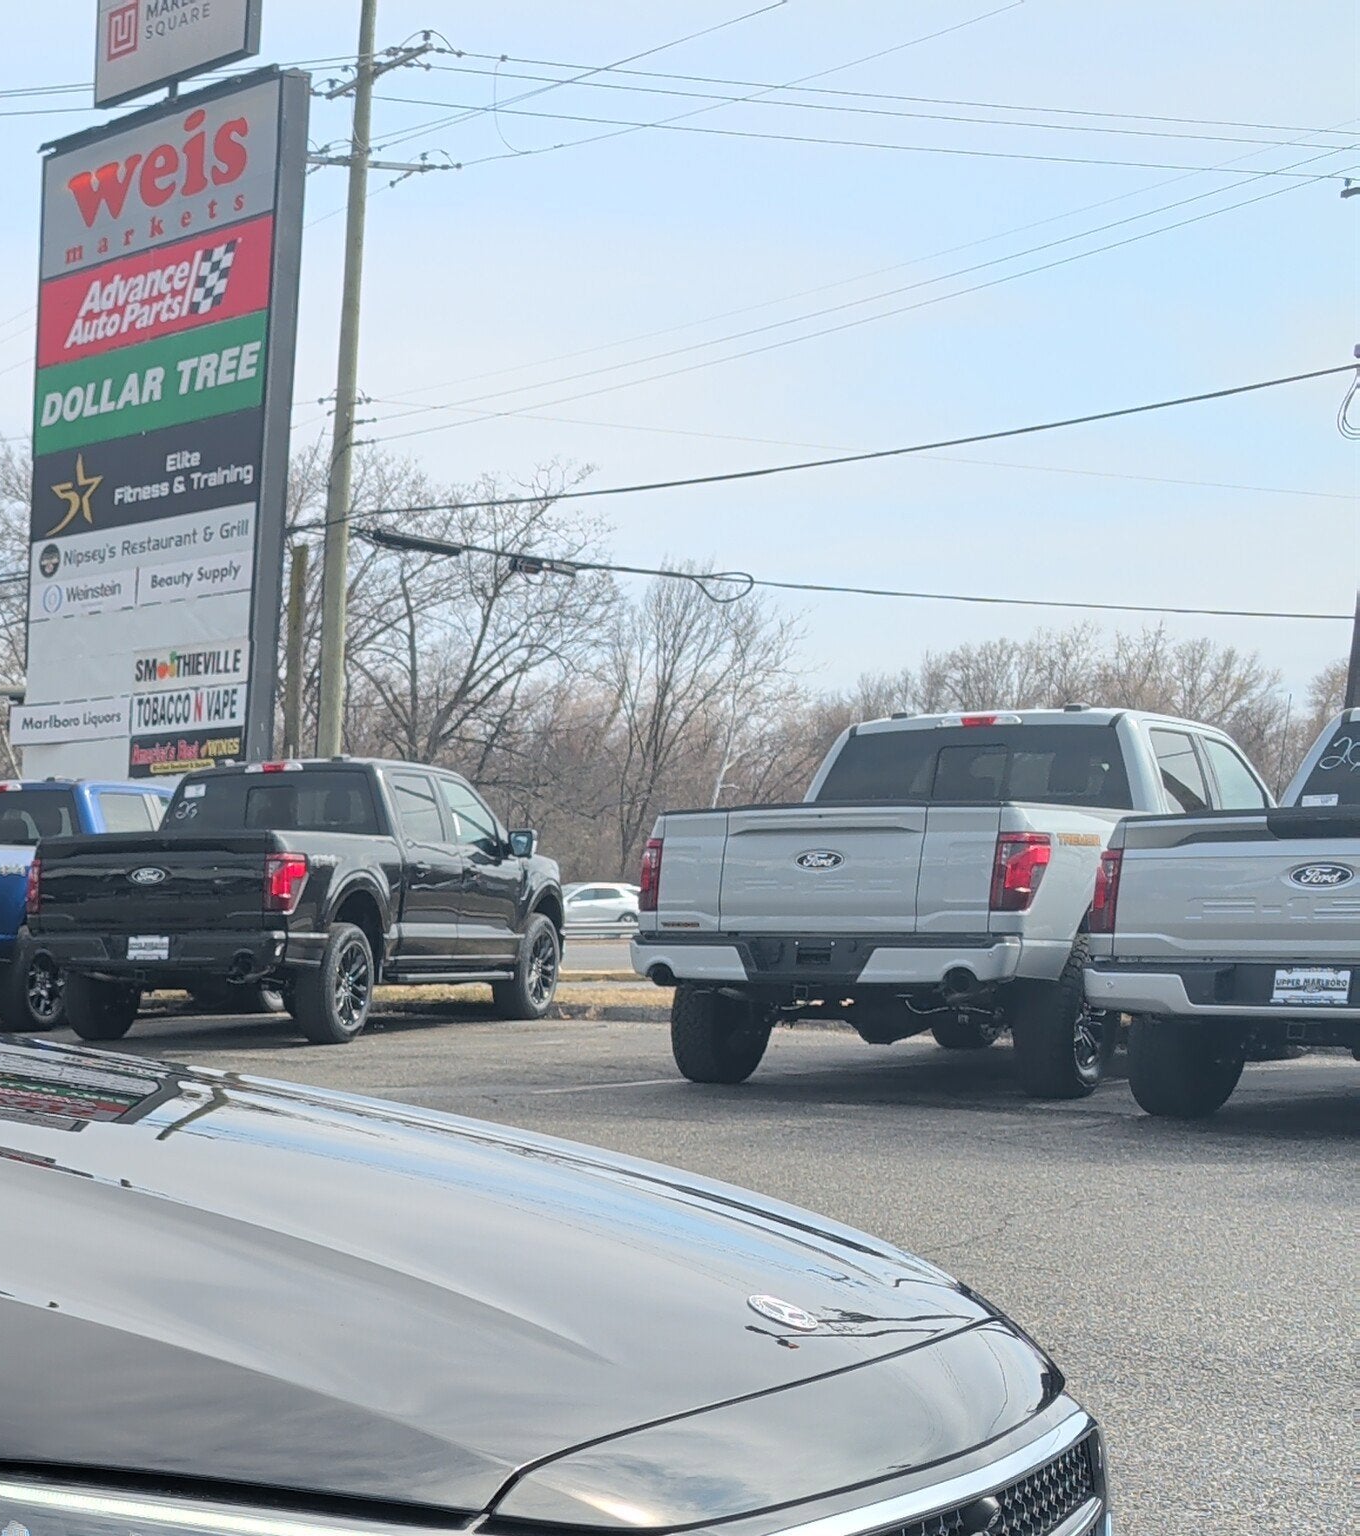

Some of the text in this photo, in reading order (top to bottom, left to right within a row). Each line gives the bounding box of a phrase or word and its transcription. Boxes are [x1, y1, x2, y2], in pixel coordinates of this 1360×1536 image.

[144, 3, 211, 40] SQUARE
[67, 108, 249, 229] weis
[65, 191, 245, 265] markets
[77, 261, 190, 318] Advance
[64, 293, 183, 349] Auto Parts
[40, 341, 262, 427] DOLLAR TREE
[166, 451, 201, 472] Elite
[113, 464, 254, 506] Fitness & Training
[63, 519, 250, 567] Nipsey's Restaurant & Grill
[65, 580, 122, 602] Weinstein
[150, 560, 242, 589] Beauty Supply
[21, 711, 122, 730] Marlboro Liquors
[137, 688, 238, 728] TOBACCO N VAPE
[1302, 978, 1348, 987] MARLBORO
